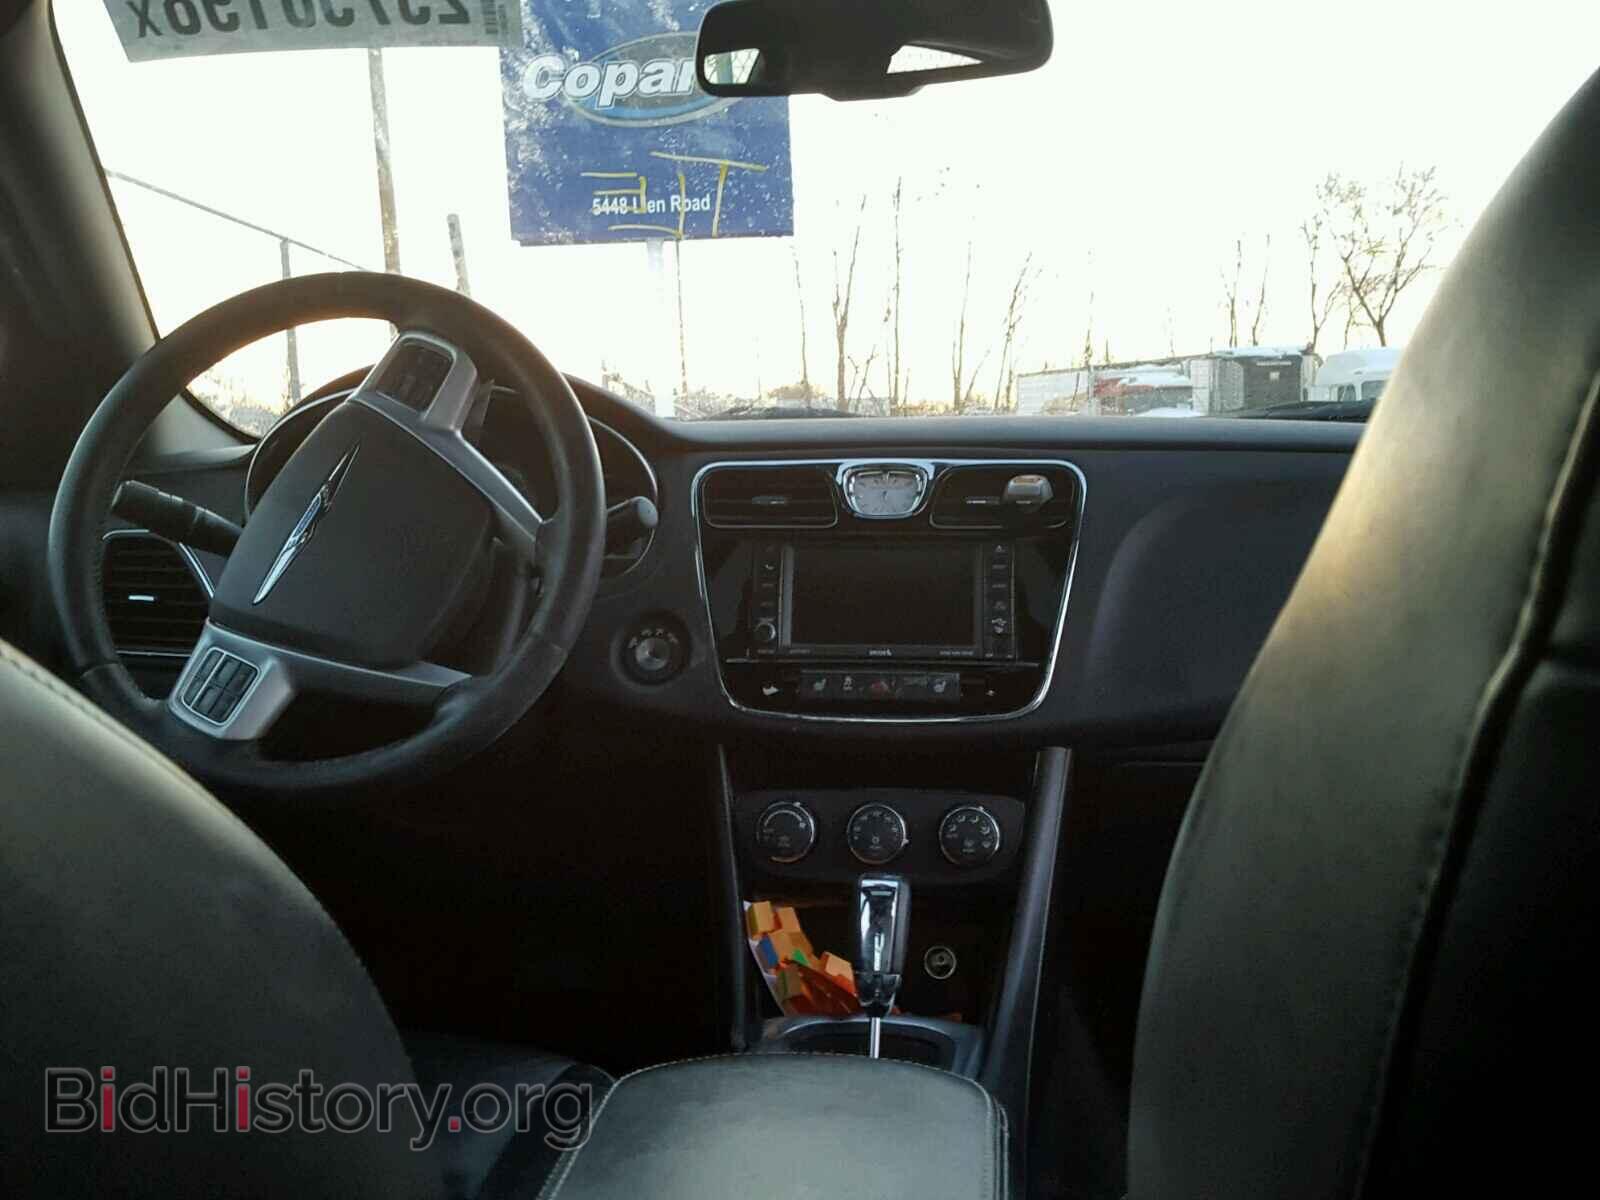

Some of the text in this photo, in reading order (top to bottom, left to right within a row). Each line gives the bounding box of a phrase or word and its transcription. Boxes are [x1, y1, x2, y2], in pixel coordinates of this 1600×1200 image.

[522, 54, 697, 109] Copar
[592, 194, 711, 215] 5448 Len Road
